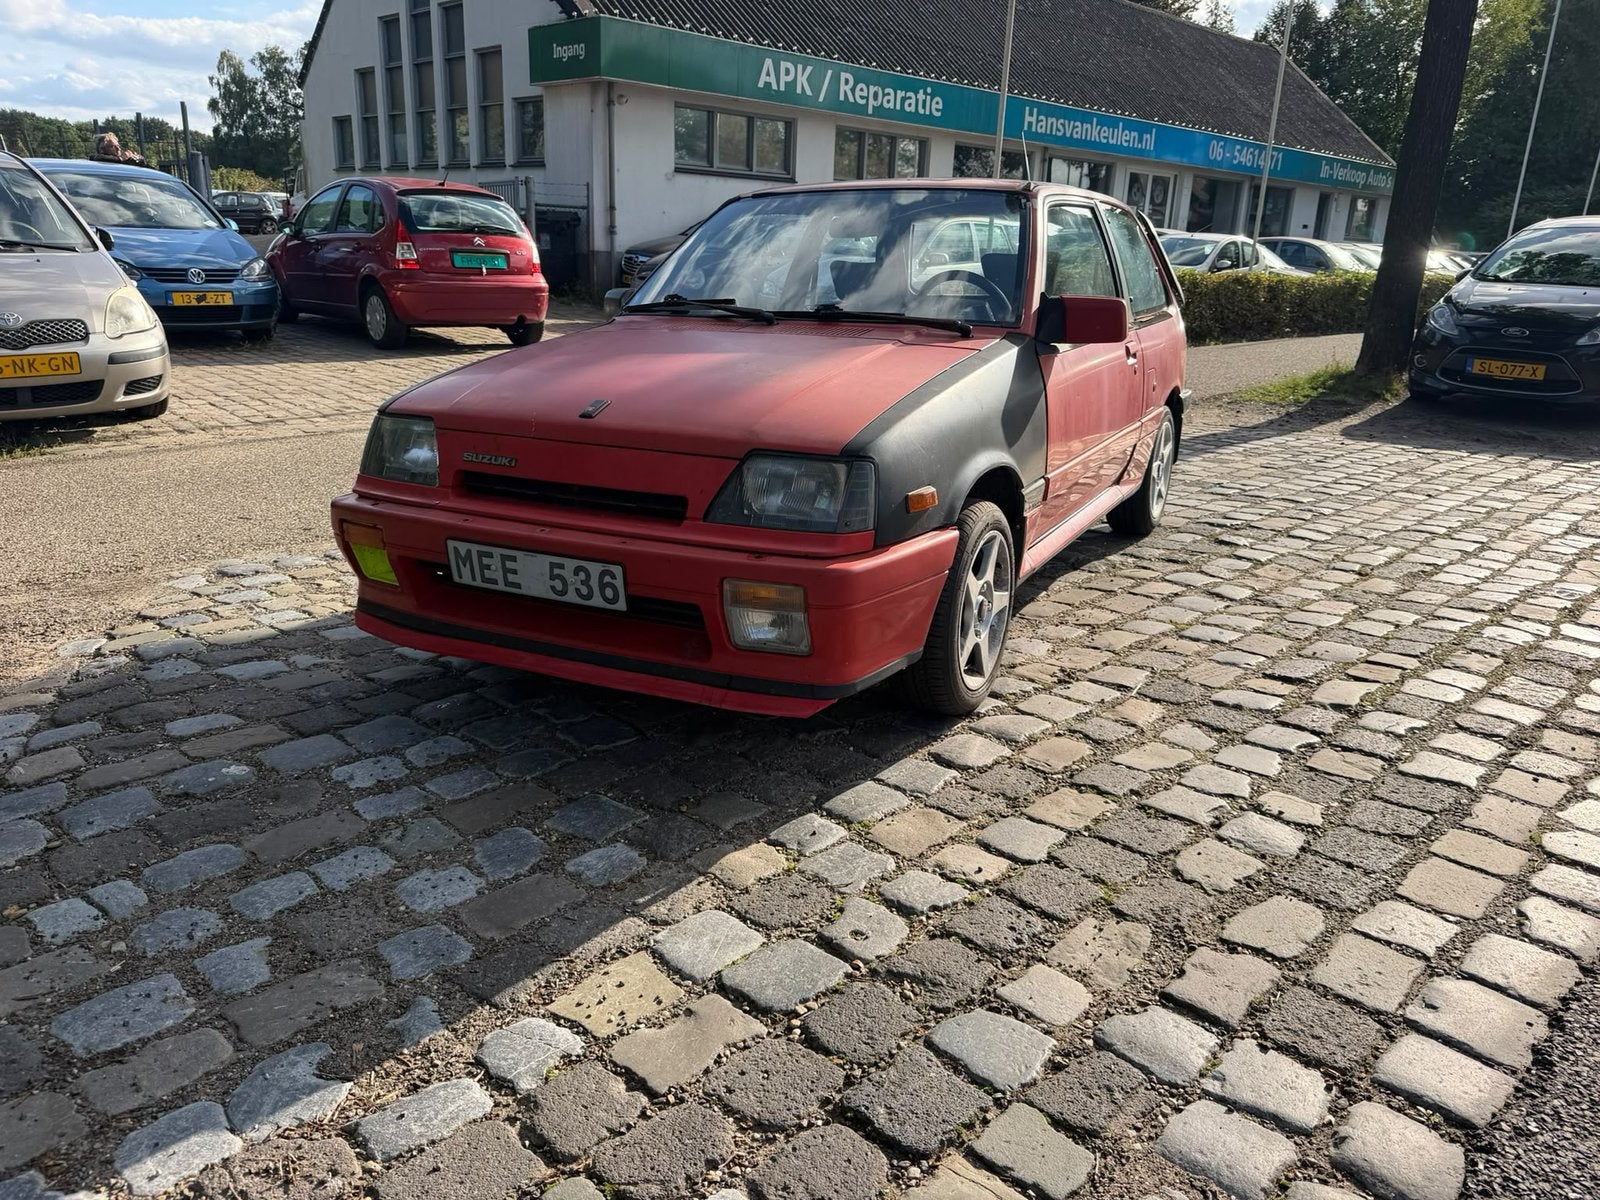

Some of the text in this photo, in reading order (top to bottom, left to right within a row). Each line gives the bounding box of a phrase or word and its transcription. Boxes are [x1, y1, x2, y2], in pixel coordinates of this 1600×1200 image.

[552, 43, 586, 62] Ingang
[757, 57, 944, 117] APK / Reparatie
[1022, 106, 1157, 151] Hansvankeulen.nl
[1208, 139, 1225, 162] 06
[1232, 144, 1284, 172] 5461471
[1320, 160, 1367, 189] In-Verkoop
[180, 293, 226, 304] 13-L-ZT
[1478, 361, 1539, 378] SL-077-X
[462, 452, 517, 467] SUZUKI
[453, 546, 620, 605] MEE 536
